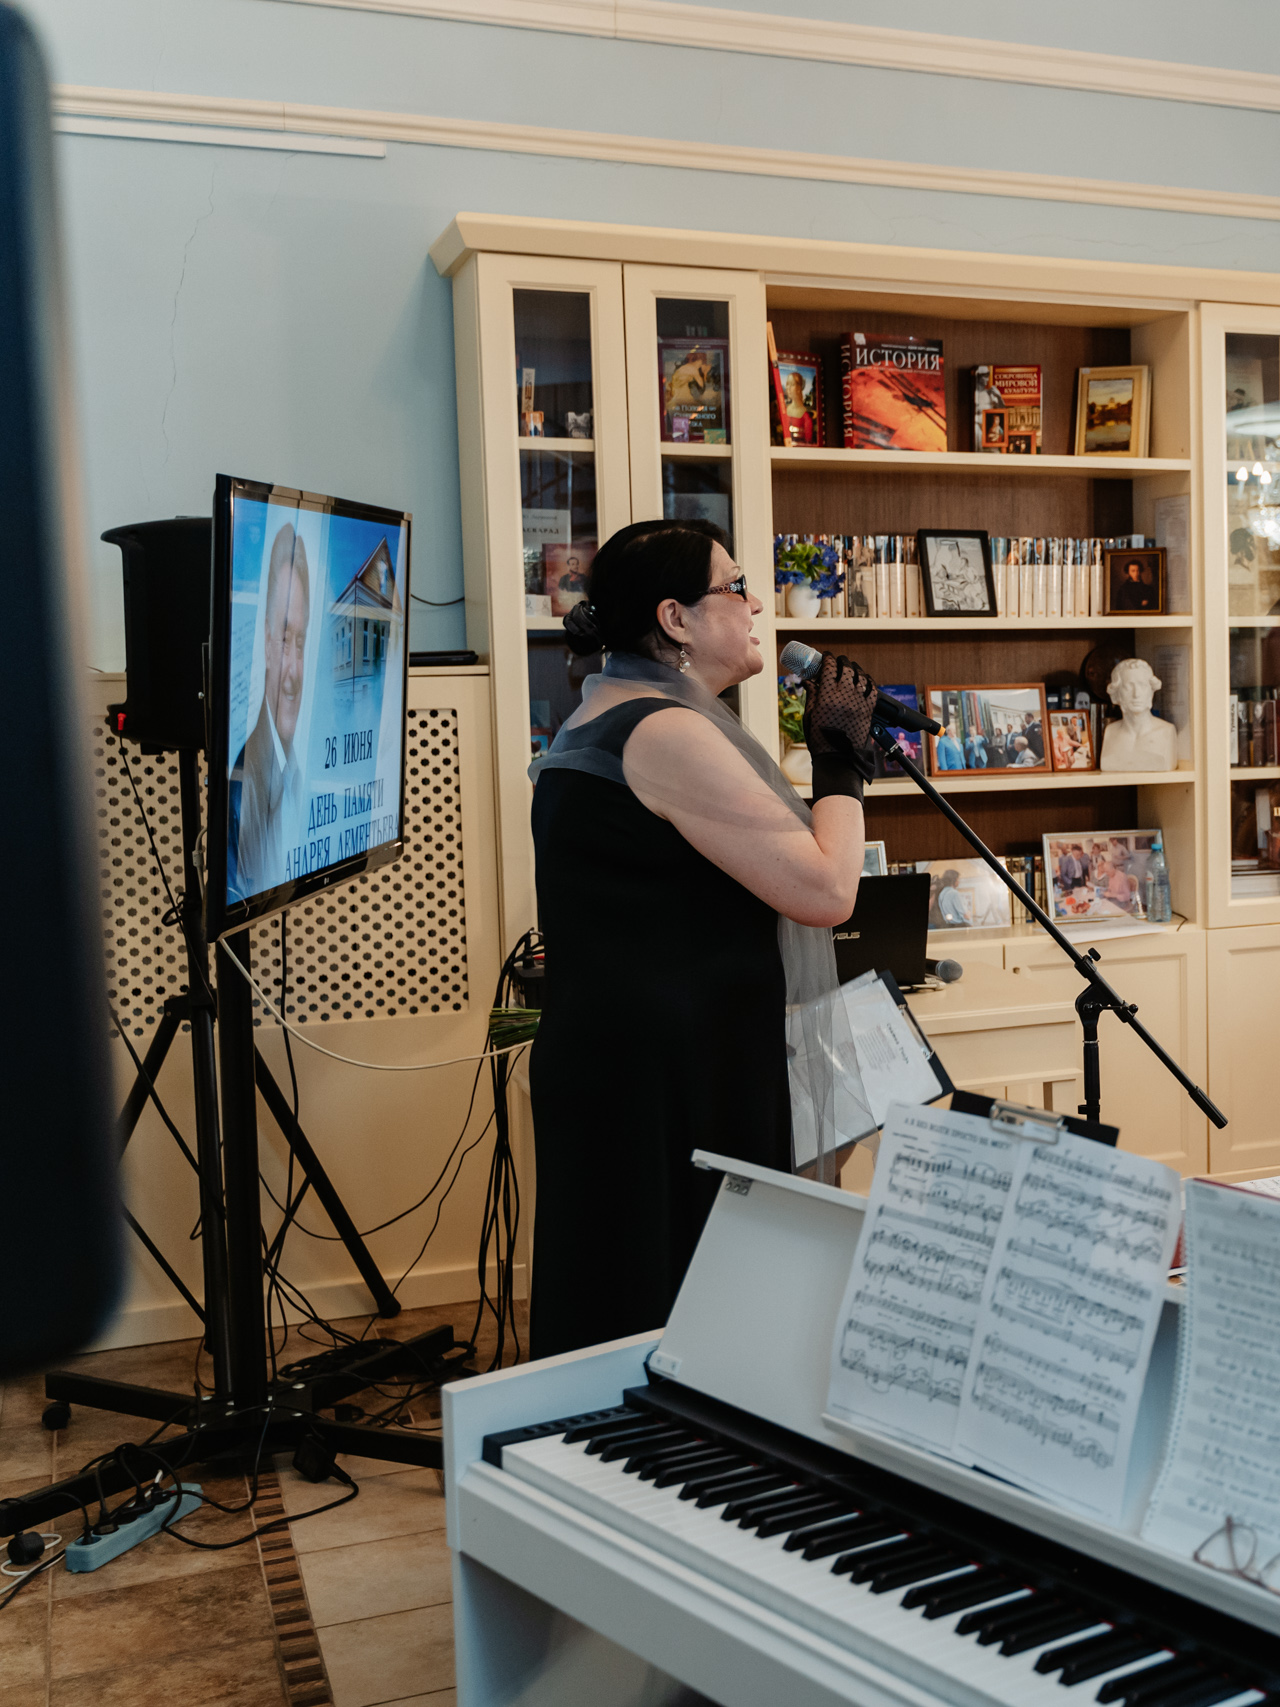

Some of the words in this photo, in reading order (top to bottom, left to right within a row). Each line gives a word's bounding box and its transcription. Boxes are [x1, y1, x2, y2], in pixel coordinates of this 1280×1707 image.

[856, 348, 940, 371] ИСТОРИЯ
[841, 345, 853, 437] ИСТОРИЯ
[325, 736, 337, 769] 26
[343, 729, 373, 765] ИЮНЯ
[308, 793, 338, 838] ДЕНЬ
[344, 778, 384, 819] ПАМЯТИ
[285, 836, 331, 882] АНДРЕЯ
